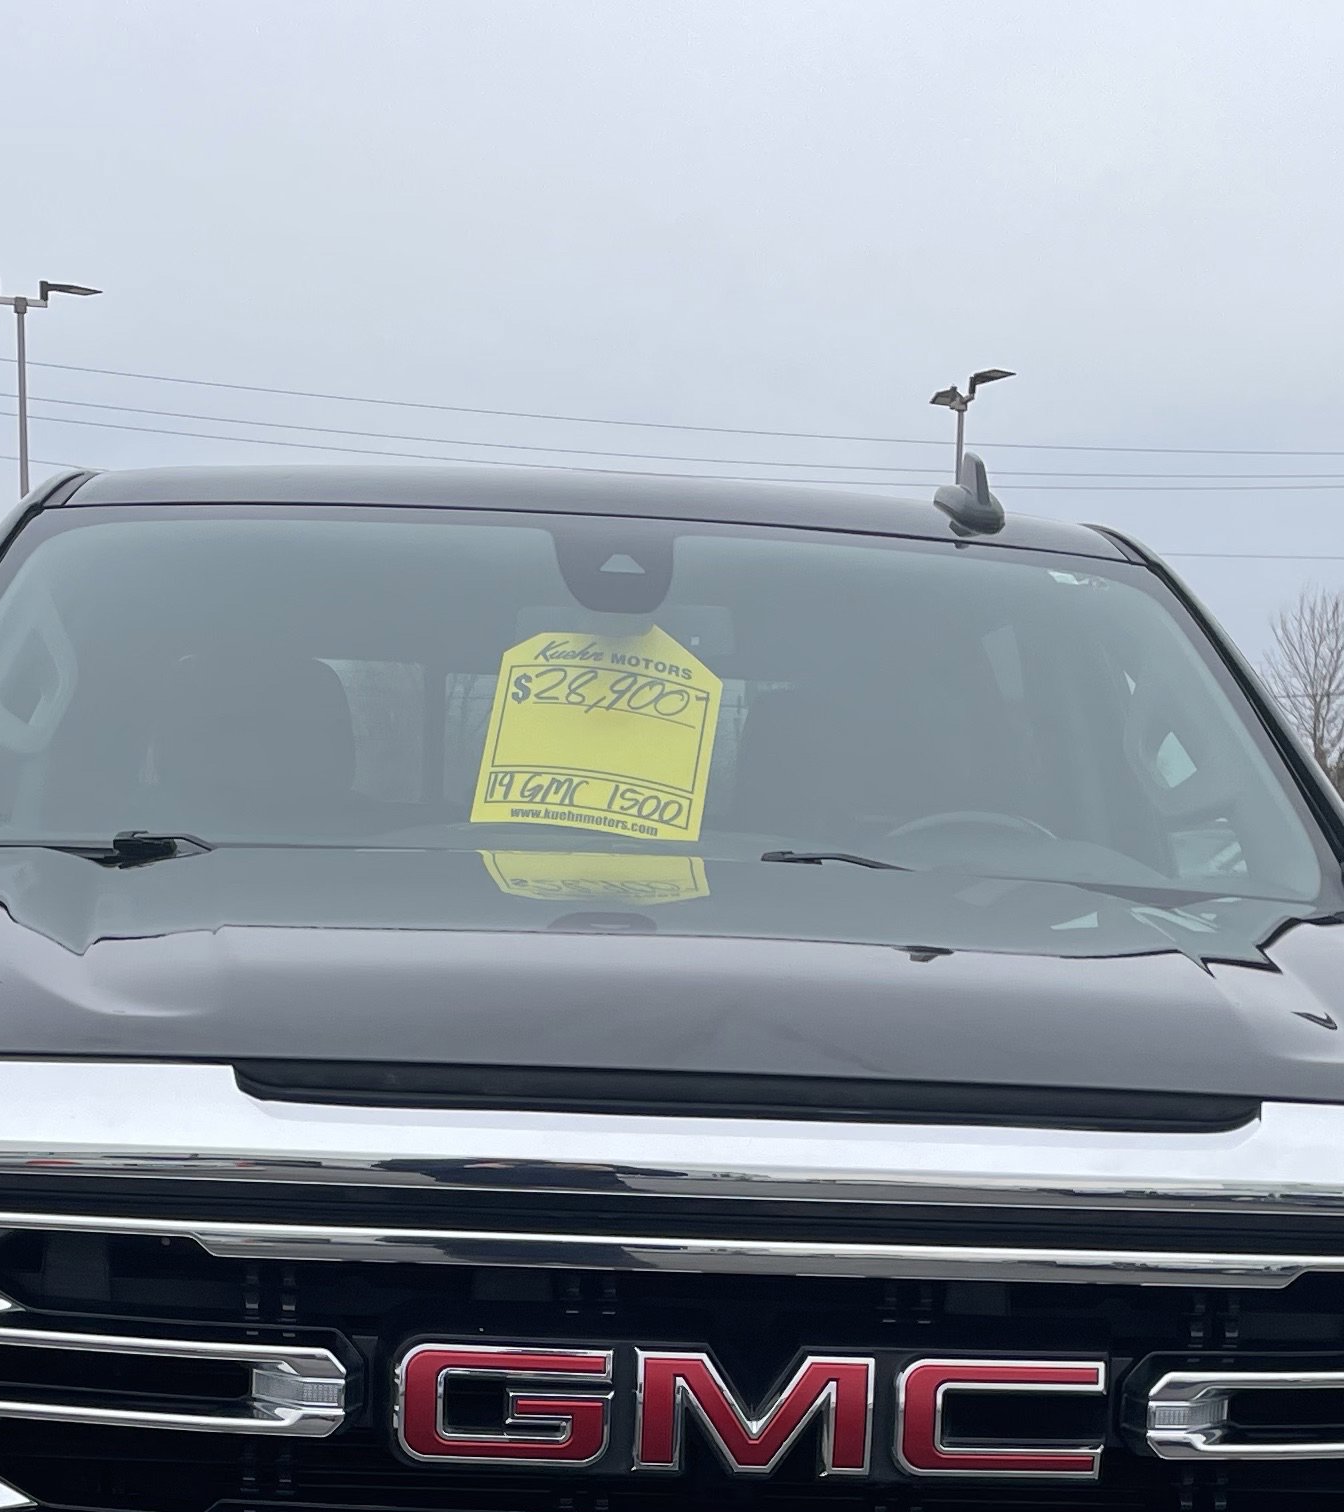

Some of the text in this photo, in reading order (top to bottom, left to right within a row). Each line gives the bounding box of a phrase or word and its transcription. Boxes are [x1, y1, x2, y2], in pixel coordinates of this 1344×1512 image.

[610, 652, 693, 681] MOTORS
[519, 773, 589, 805] GMC
[606, 784, 684, 826] 1500
[393, 1342, 1107, 1481] GMC
